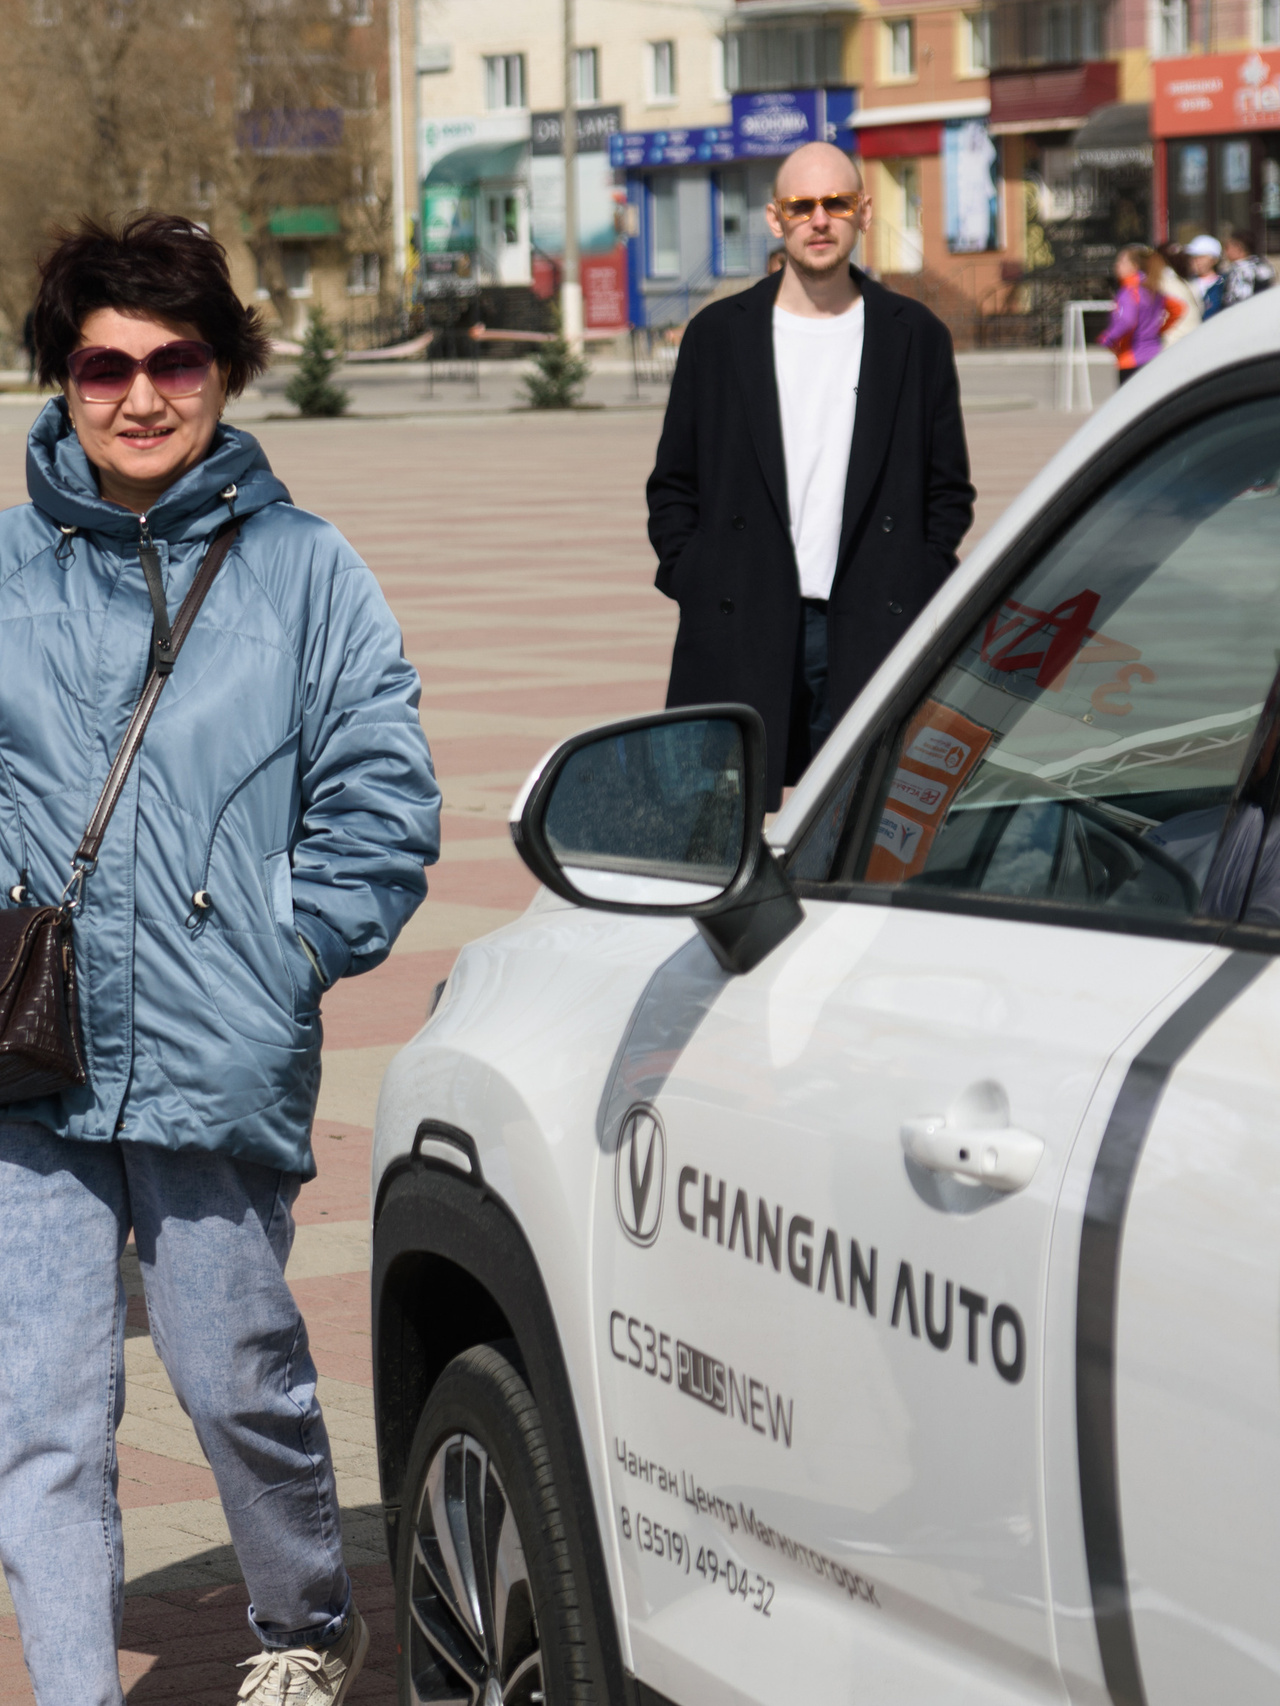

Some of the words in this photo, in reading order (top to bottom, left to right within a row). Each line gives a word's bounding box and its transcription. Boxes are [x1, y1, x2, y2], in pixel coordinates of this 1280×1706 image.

[537, 113, 619, 141] ORILAME
[677, 1164, 879, 1318] CHANGAN
[890, 1258, 1028, 1386] AUTO
[614, 1436, 679, 1498] Чанган
[682, 1469, 739, 1535] Центр
[739, 1501, 882, 1609] Магнитогорск
[621, 1505, 632, 1541] 8
[637, 1511, 690, 1575] (3519)
[696, 1545, 776, 1618] 49-04-32
